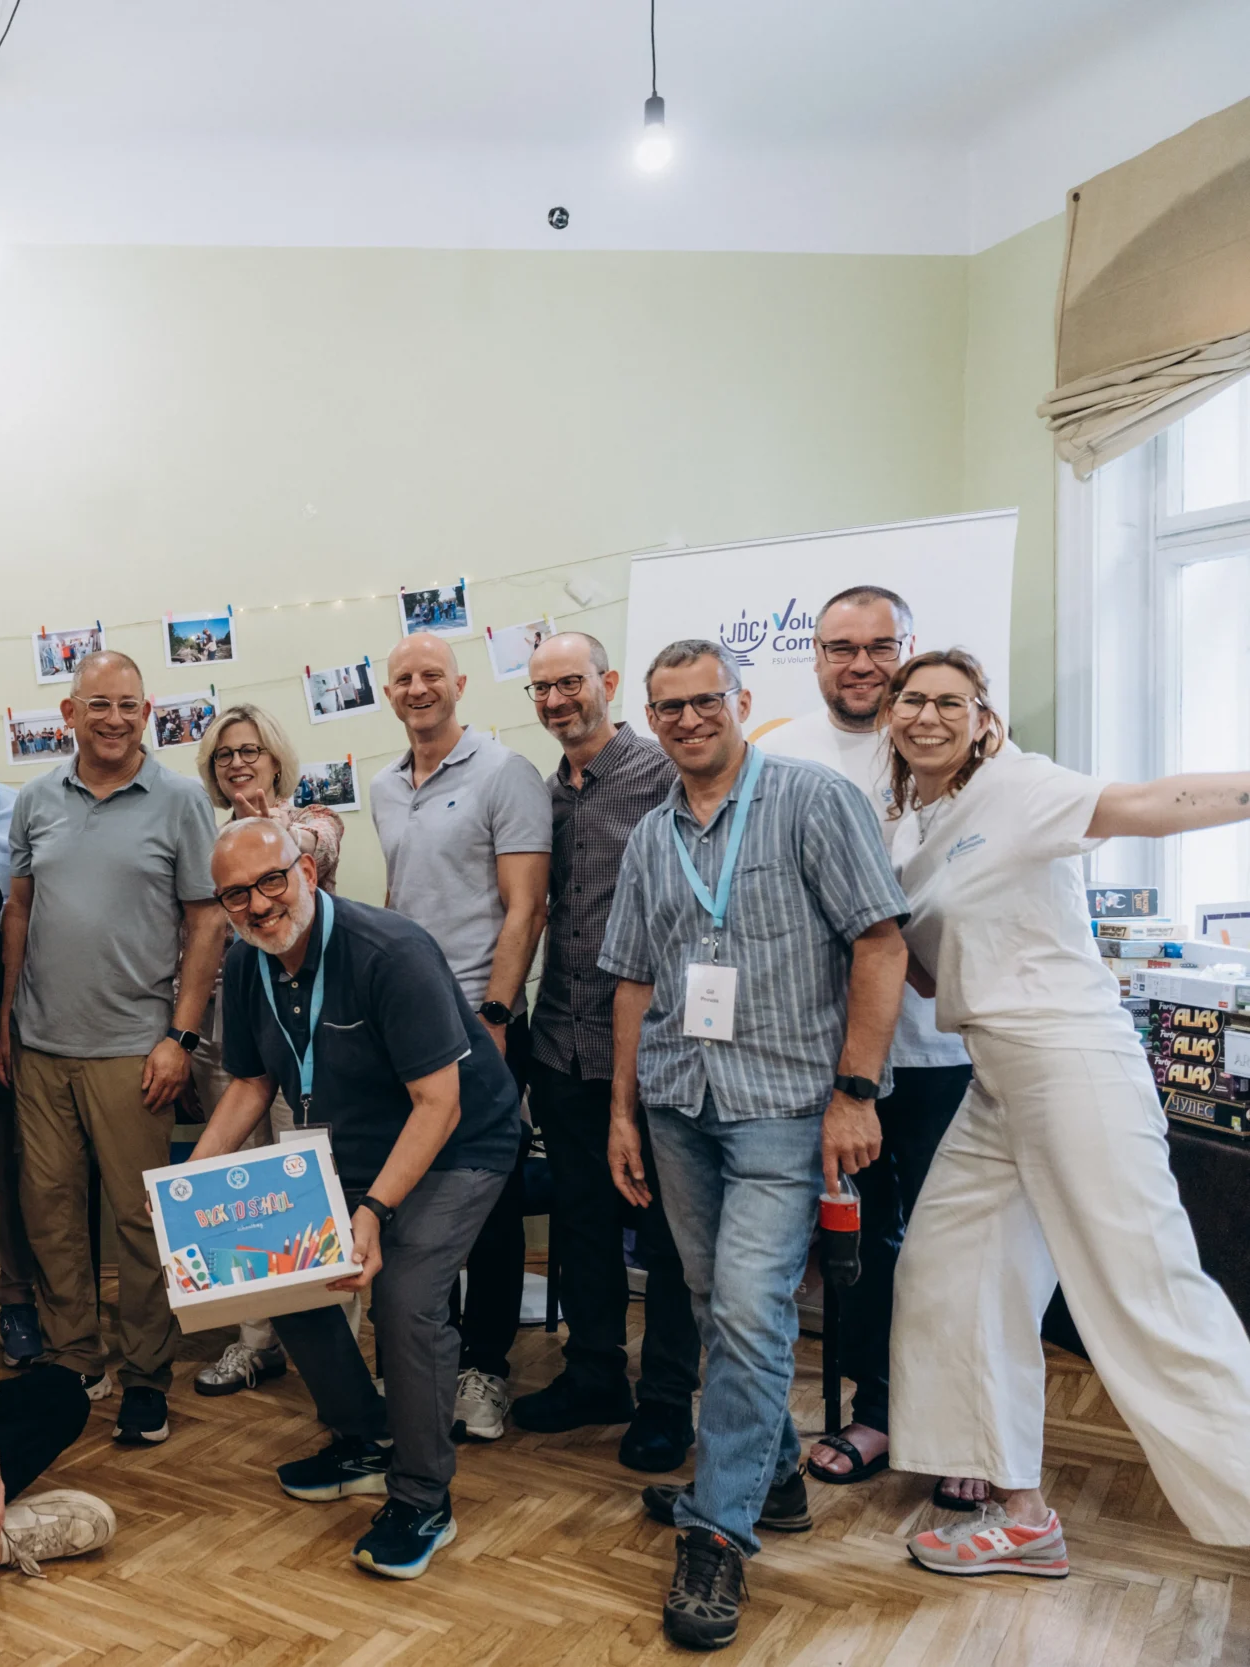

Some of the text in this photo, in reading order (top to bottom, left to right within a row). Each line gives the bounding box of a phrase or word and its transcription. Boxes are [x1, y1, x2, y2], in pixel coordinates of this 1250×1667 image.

[727, 621, 759, 643] JDC
[1158, 1002, 1176, 1013] Party
[1174, 1008, 1219, 1034] ALIAS
[1159, 1029, 1177, 1040] Party
[1173, 1036, 1216, 1063] ALIAS
[1154, 1056, 1172, 1068] Party
[1168, 1063, 1212, 1091] ALIAS
[1171, 1095, 1215, 1119] ЧУДЕС
[194, 1191, 294, 1228] BACK TO SCHOOL
